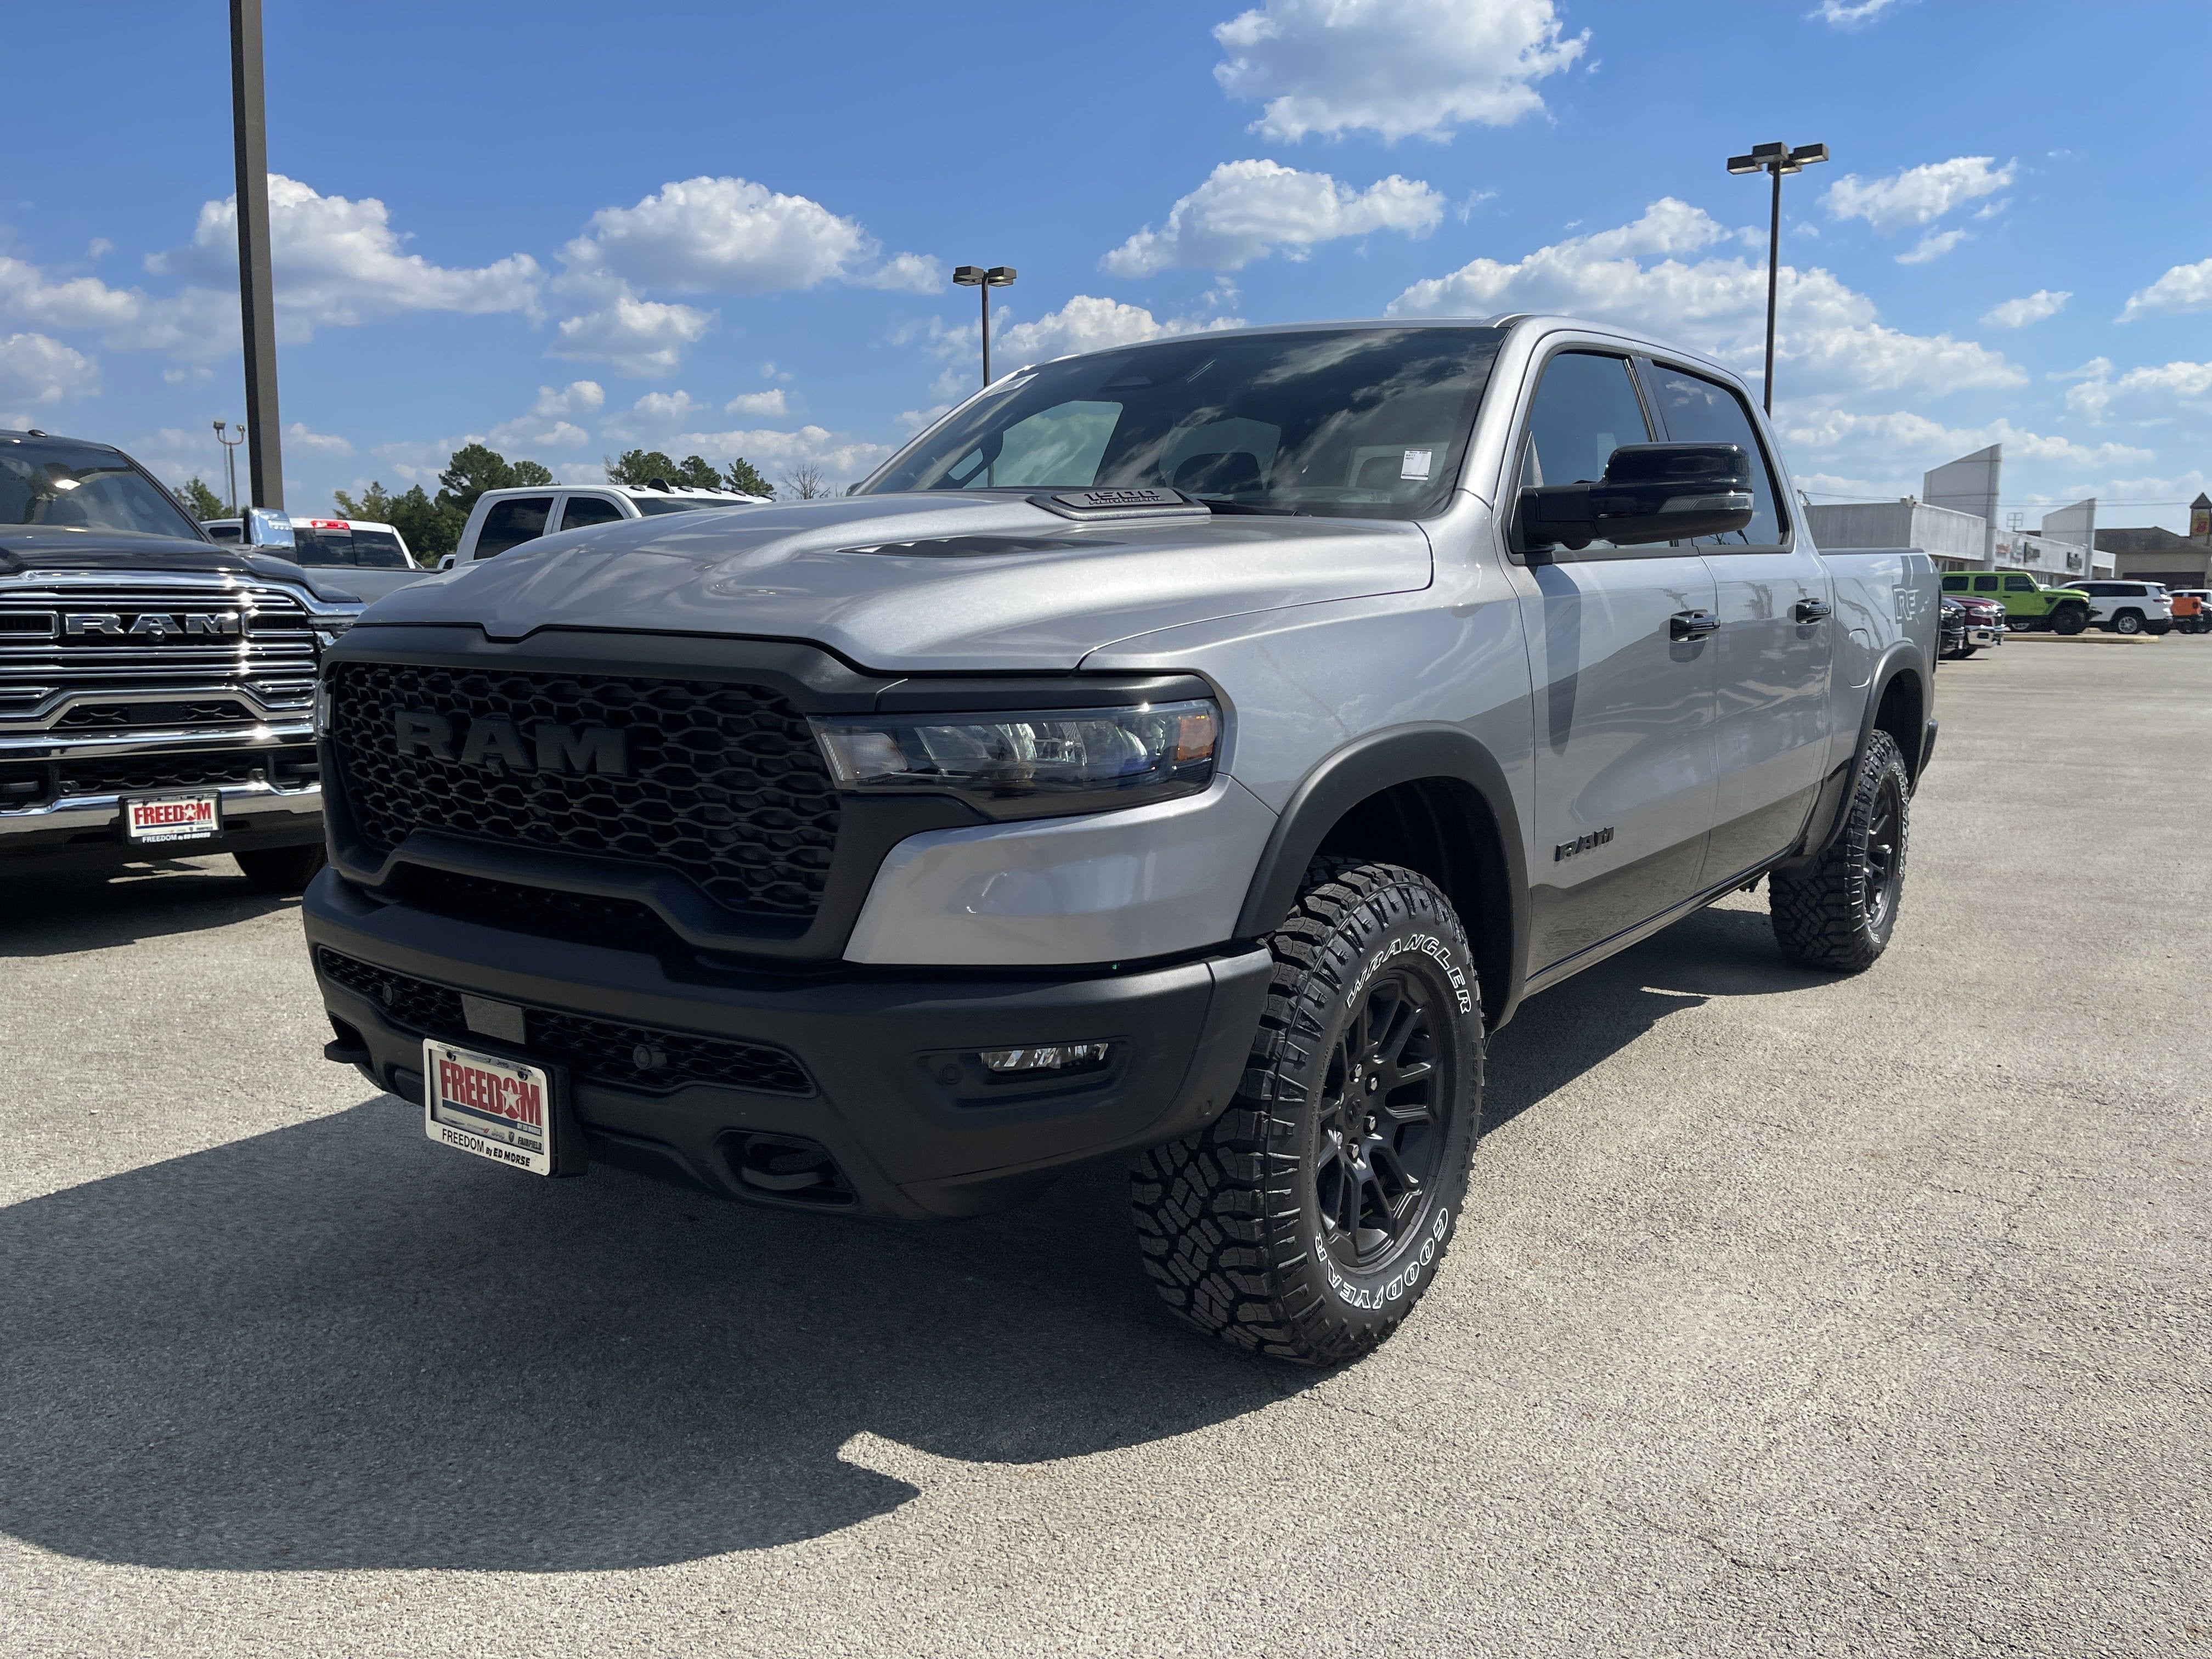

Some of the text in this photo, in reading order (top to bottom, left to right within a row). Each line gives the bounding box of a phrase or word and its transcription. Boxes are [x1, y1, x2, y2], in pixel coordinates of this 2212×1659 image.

[65, 613, 240, 634] RAM
[394, 711, 628, 777] RAM
[134, 803, 211, 825] FREEDOM
[143, 834, 177, 843] FREEDOM
[1554, 826, 1615, 861] RAM
[1346, 934, 1471, 1014] WRANGLER
[439, 1059, 542, 1127] FREEDOM
[442, 1128, 484, 1153] FREEDOM
[494, 1148, 503, 1159] ED
[504, 1150, 531, 1167] MORSE
[1314, 1232, 1448, 1310] GOODYEAR
